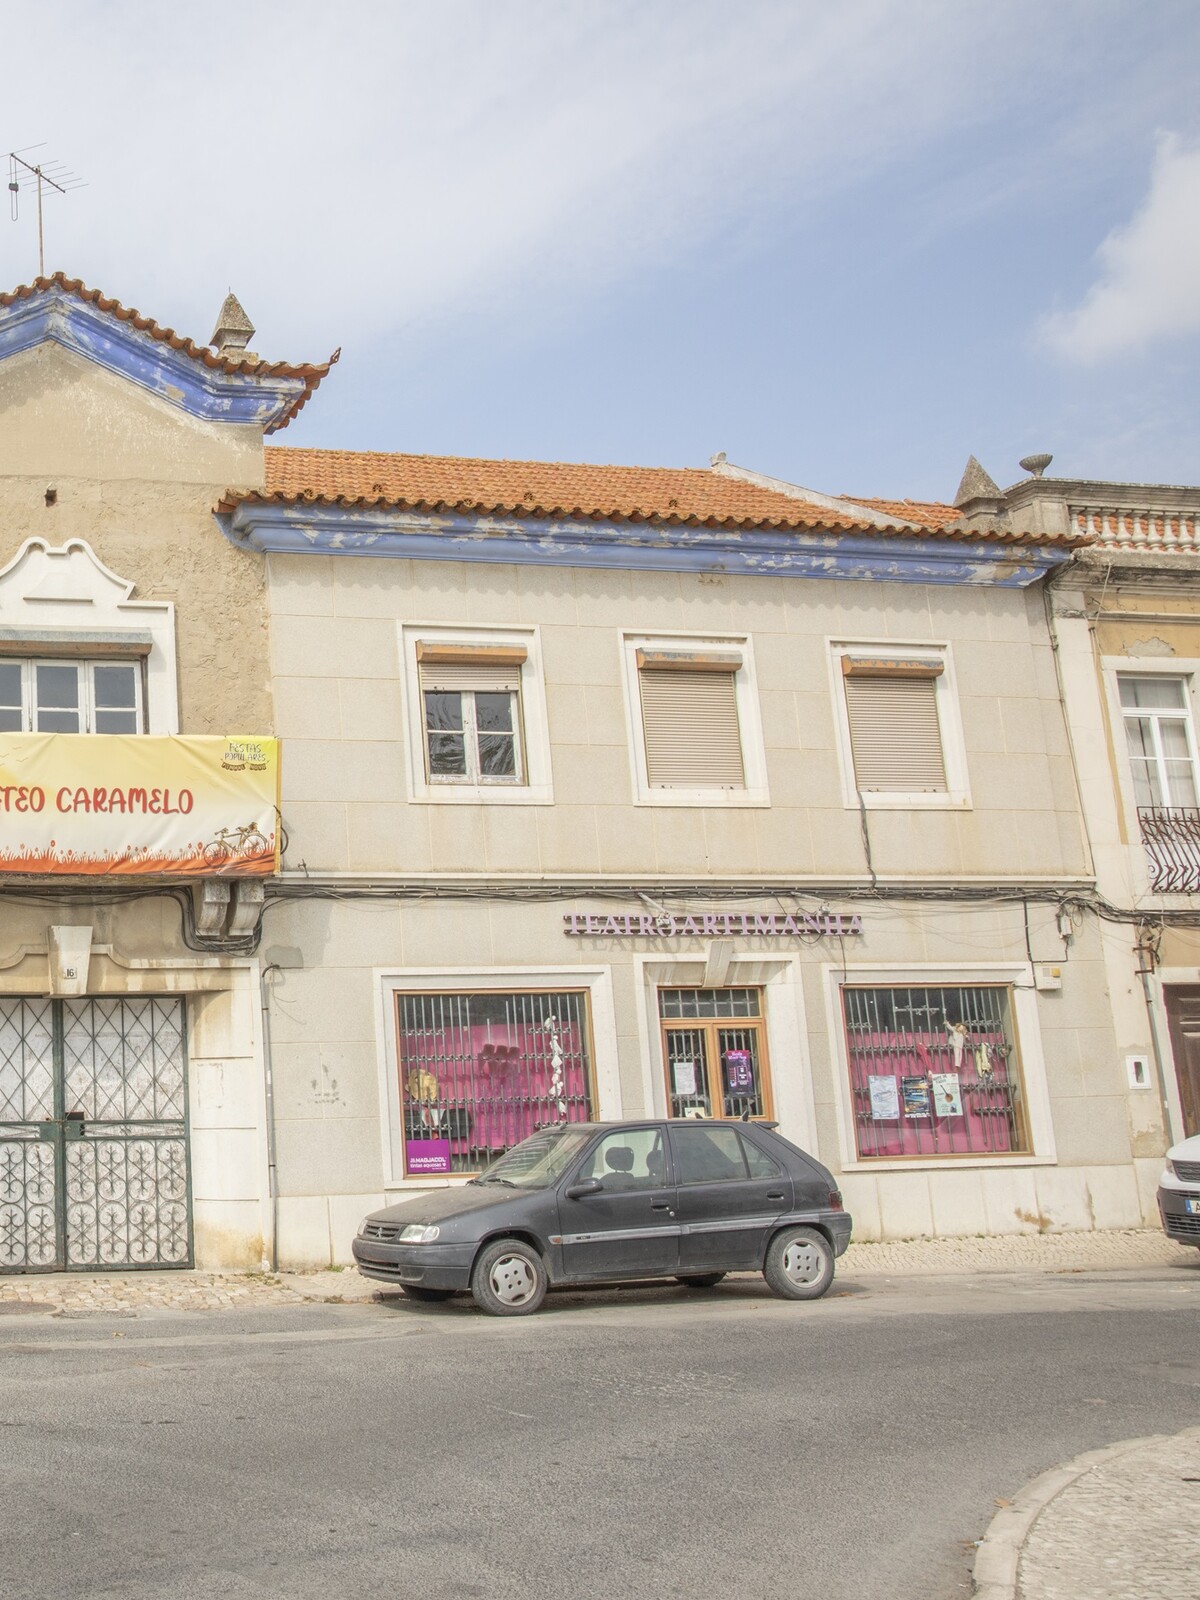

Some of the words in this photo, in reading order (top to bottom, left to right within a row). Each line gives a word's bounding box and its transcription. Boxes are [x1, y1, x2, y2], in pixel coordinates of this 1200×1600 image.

[229, 743, 262, 753] FESTAS
[224, 752, 266, 762] POPULARES
[56, 786, 194, 815] CARAMELO
[66, 968, 74, 977] 16
